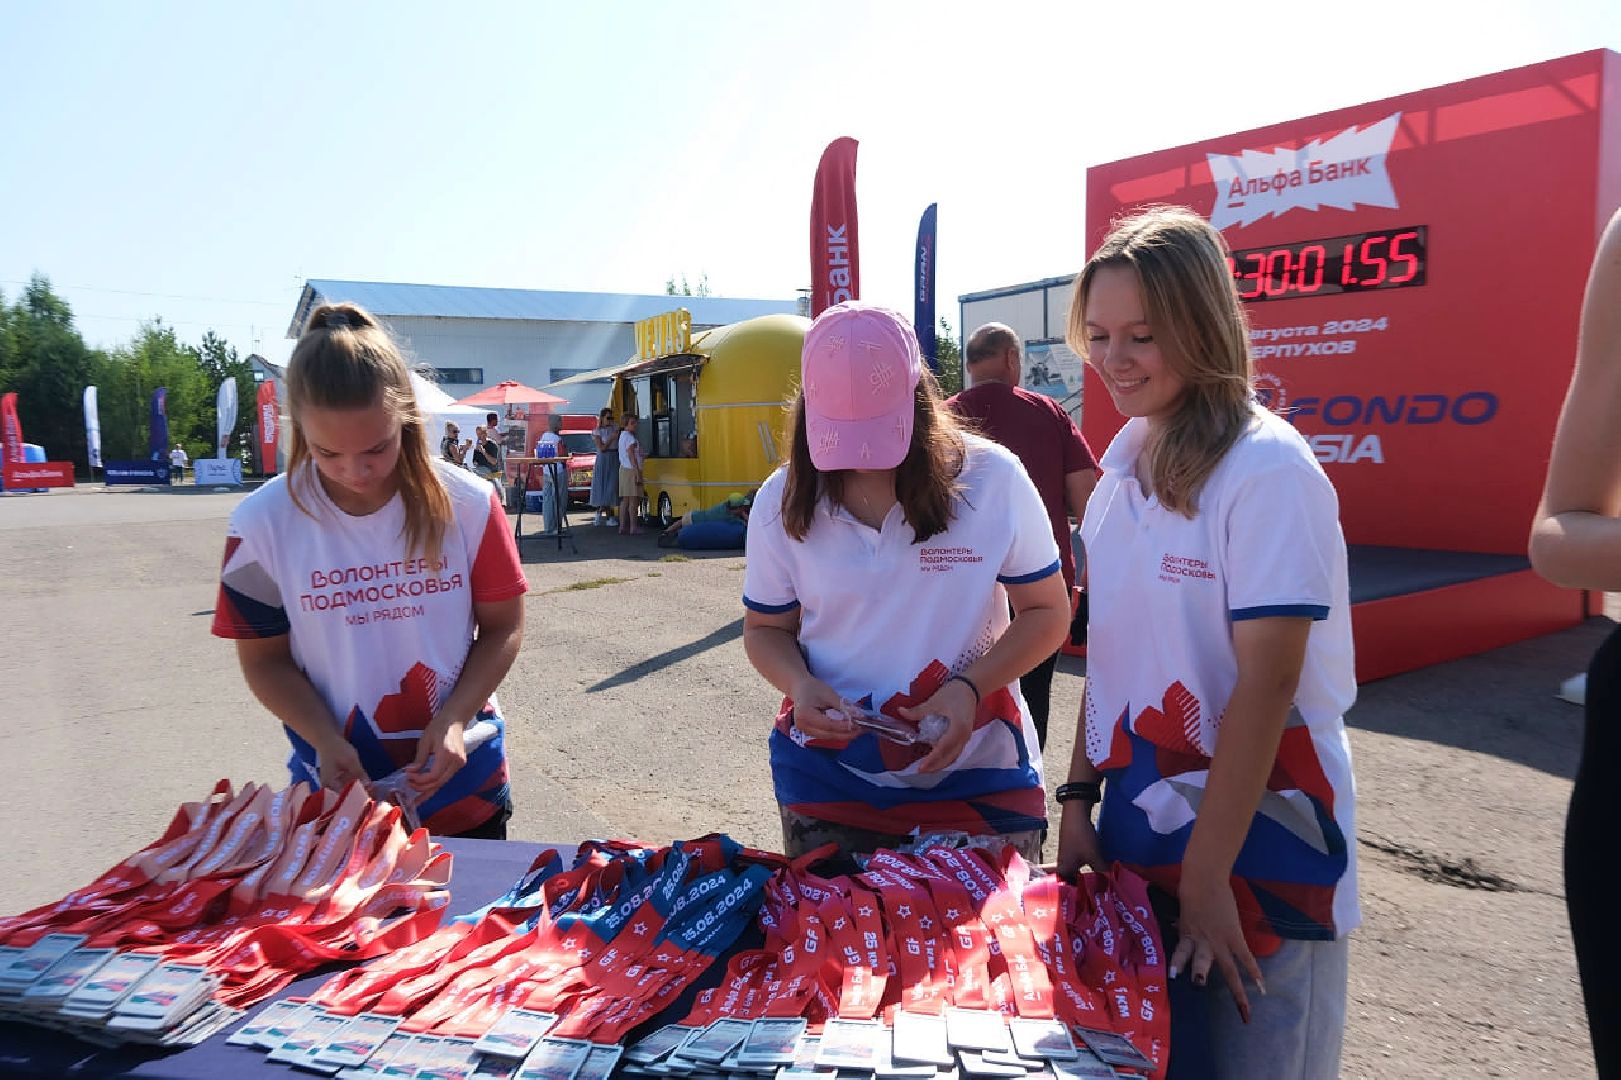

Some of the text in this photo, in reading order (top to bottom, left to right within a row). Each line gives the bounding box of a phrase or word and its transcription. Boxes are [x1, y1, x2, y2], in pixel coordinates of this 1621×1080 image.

[1228, 158, 1371, 200] Альфа Банк
[1322, 316, 1389, 335] 2024
[1250, 340, 1356, 359] ЕРПУХОВ
[300, 574, 463, 612] ПОДМОСКОВЬЯ
[345, 605, 425, 626] МЫ РЯДОМ
[805, 929, 818, 953] GF
[1141, 999, 1154, 1021] GF
